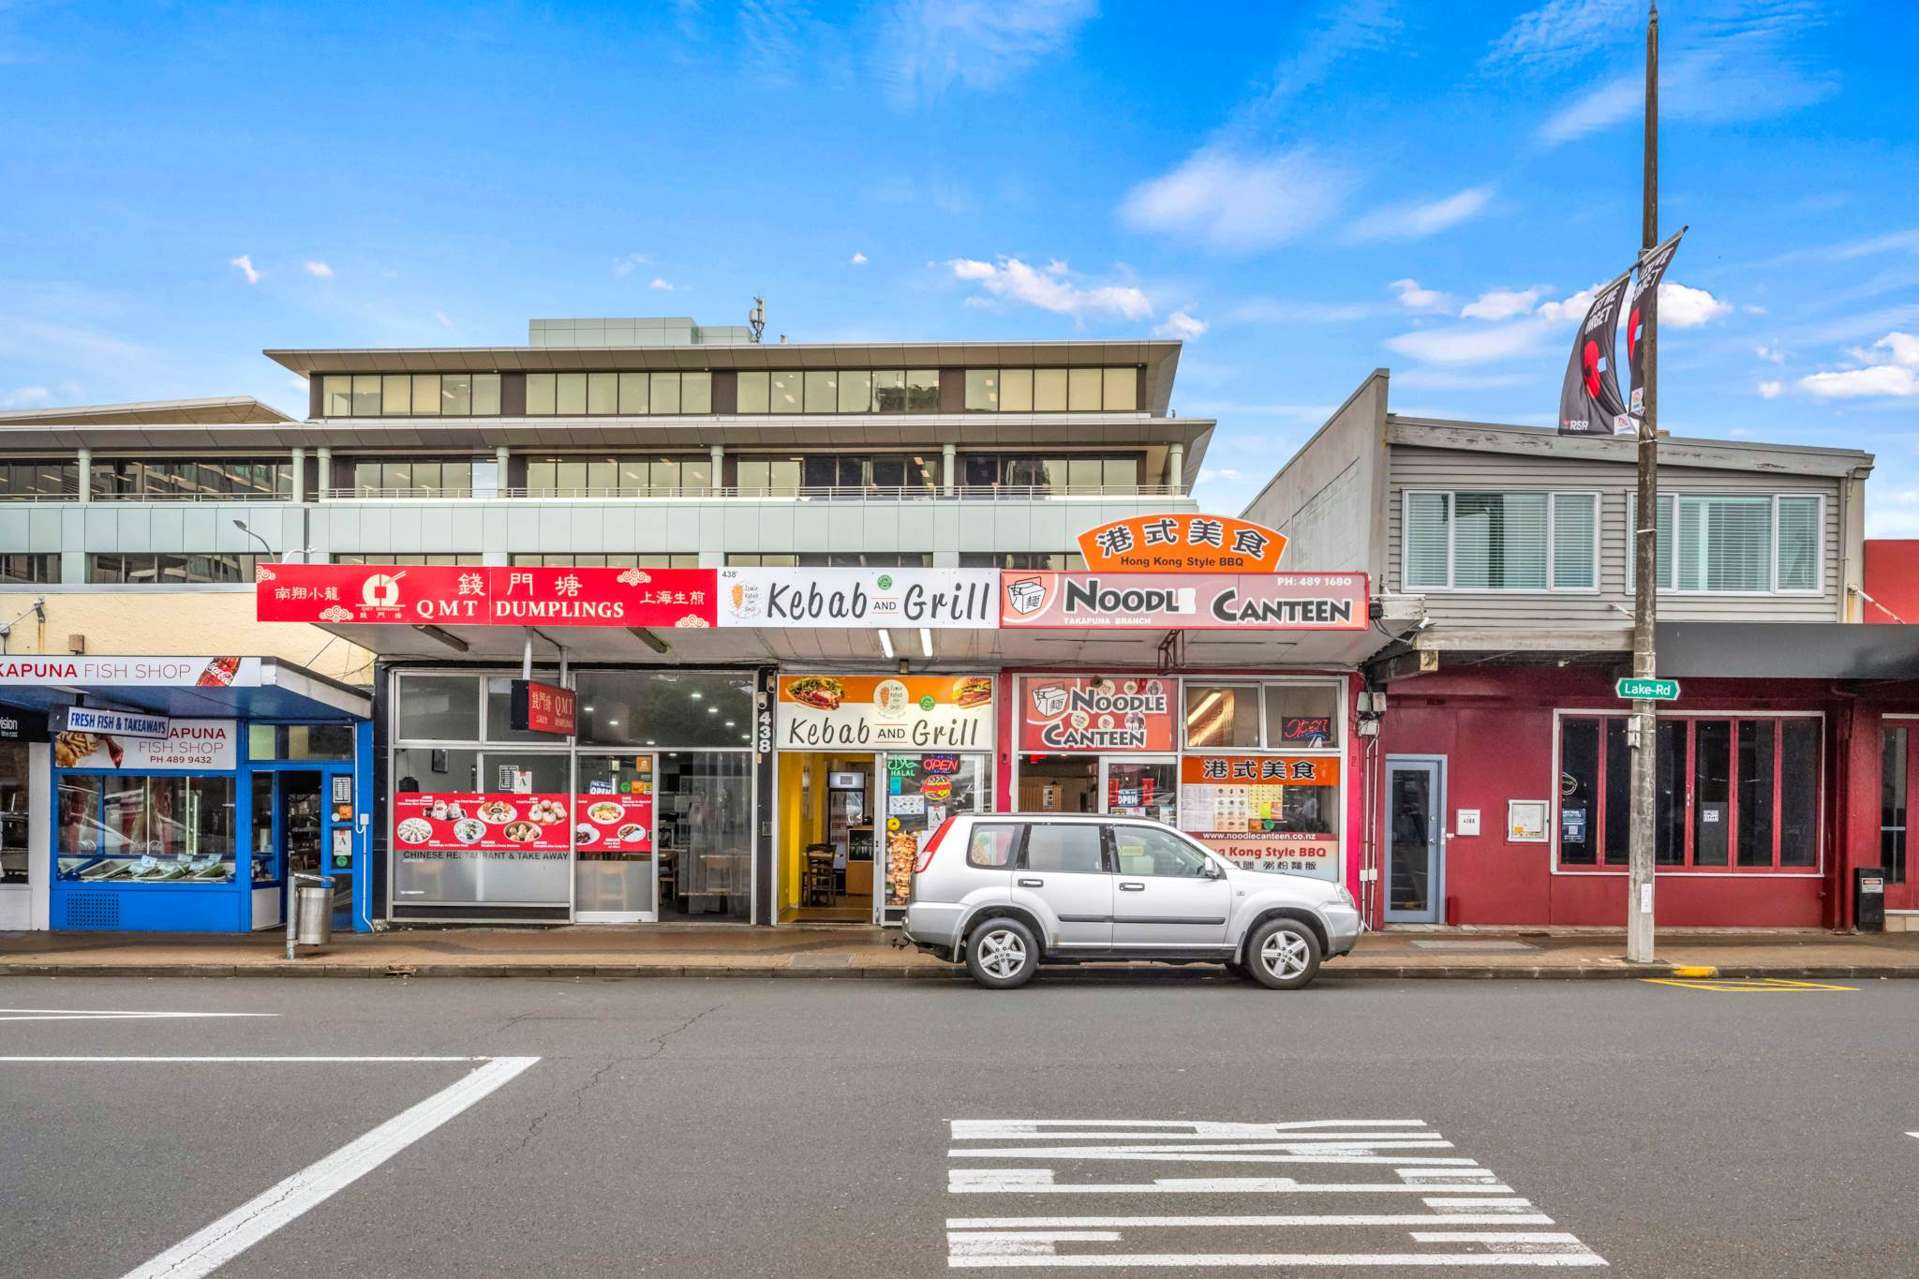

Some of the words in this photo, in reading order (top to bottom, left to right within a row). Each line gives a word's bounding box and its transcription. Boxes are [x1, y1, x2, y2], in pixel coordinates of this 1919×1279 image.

[1098, 519, 1269, 558] 港式美食
[1121, 556, 1150, 568] Hong
[1153, 556, 1182, 568] Kong
[1186, 556, 1216, 568] Style
[1219, 556, 1244, 567] BBQ
[721, 570, 737, 578] 438
[1277, 576, 1297, 587] PH:
[1300, 576, 1322, 587] 489
[1324, 576, 1353, 587] 1680
[767, 581, 868, 620] Kebab
[873, 601, 897, 610] AND
[904, 582, 990, 621] Grill
[1064, 577, 1196, 614] NOODL
[1212, 587, 1352, 625] CANTEEN
[416, 600, 479, 619] QMT
[495, 601, 625, 618] DUMPLINGS
[1064, 617, 1112, 625] TAKAPUNA
[1115, 617, 1152, 625] BRANCH
[84, 663, 128, 678] FISH
[135, 664, 191, 679] SHOP
[554, 695, 574, 717] QMT
[1070, 687, 1166, 712] NOODLE
[70, 712, 96, 727] FRESH
[97, 715, 115, 729] FISH
[115, 717, 122, 730] &
[124, 717, 166, 734] TAKEAWAYS
[758, 711, 771, 753] 438
[789, 717, 870, 746] Kebab
[877, 728, 906, 739] AND
[912, 718, 978, 746] Grill
[1042, 721, 1146, 746] CANTEEN
[138, 741, 173, 753] FISH
[179, 741, 224, 754] SHOP
[150, 755, 164, 763] PH
[167, 755, 185, 764] 489
[187, 755, 212, 764] 9432
[923, 759, 959, 771] OPEN
[890, 769, 915, 777] HALAL
[1204, 760, 1316, 780] 港式美食
[1203, 832, 1317, 841] www.noodlecanteen.co.nz
[402, 850, 443, 859] CHINESE
[446, 851, 506, 860] RETAURANT
[517, 852, 541, 860] TAKE
[543, 852, 569, 860] AWAY
[1229, 846, 1262, 860] Kong
[1265, 846, 1296, 860] Style
[1299, 847, 1327, 858] BBQ
